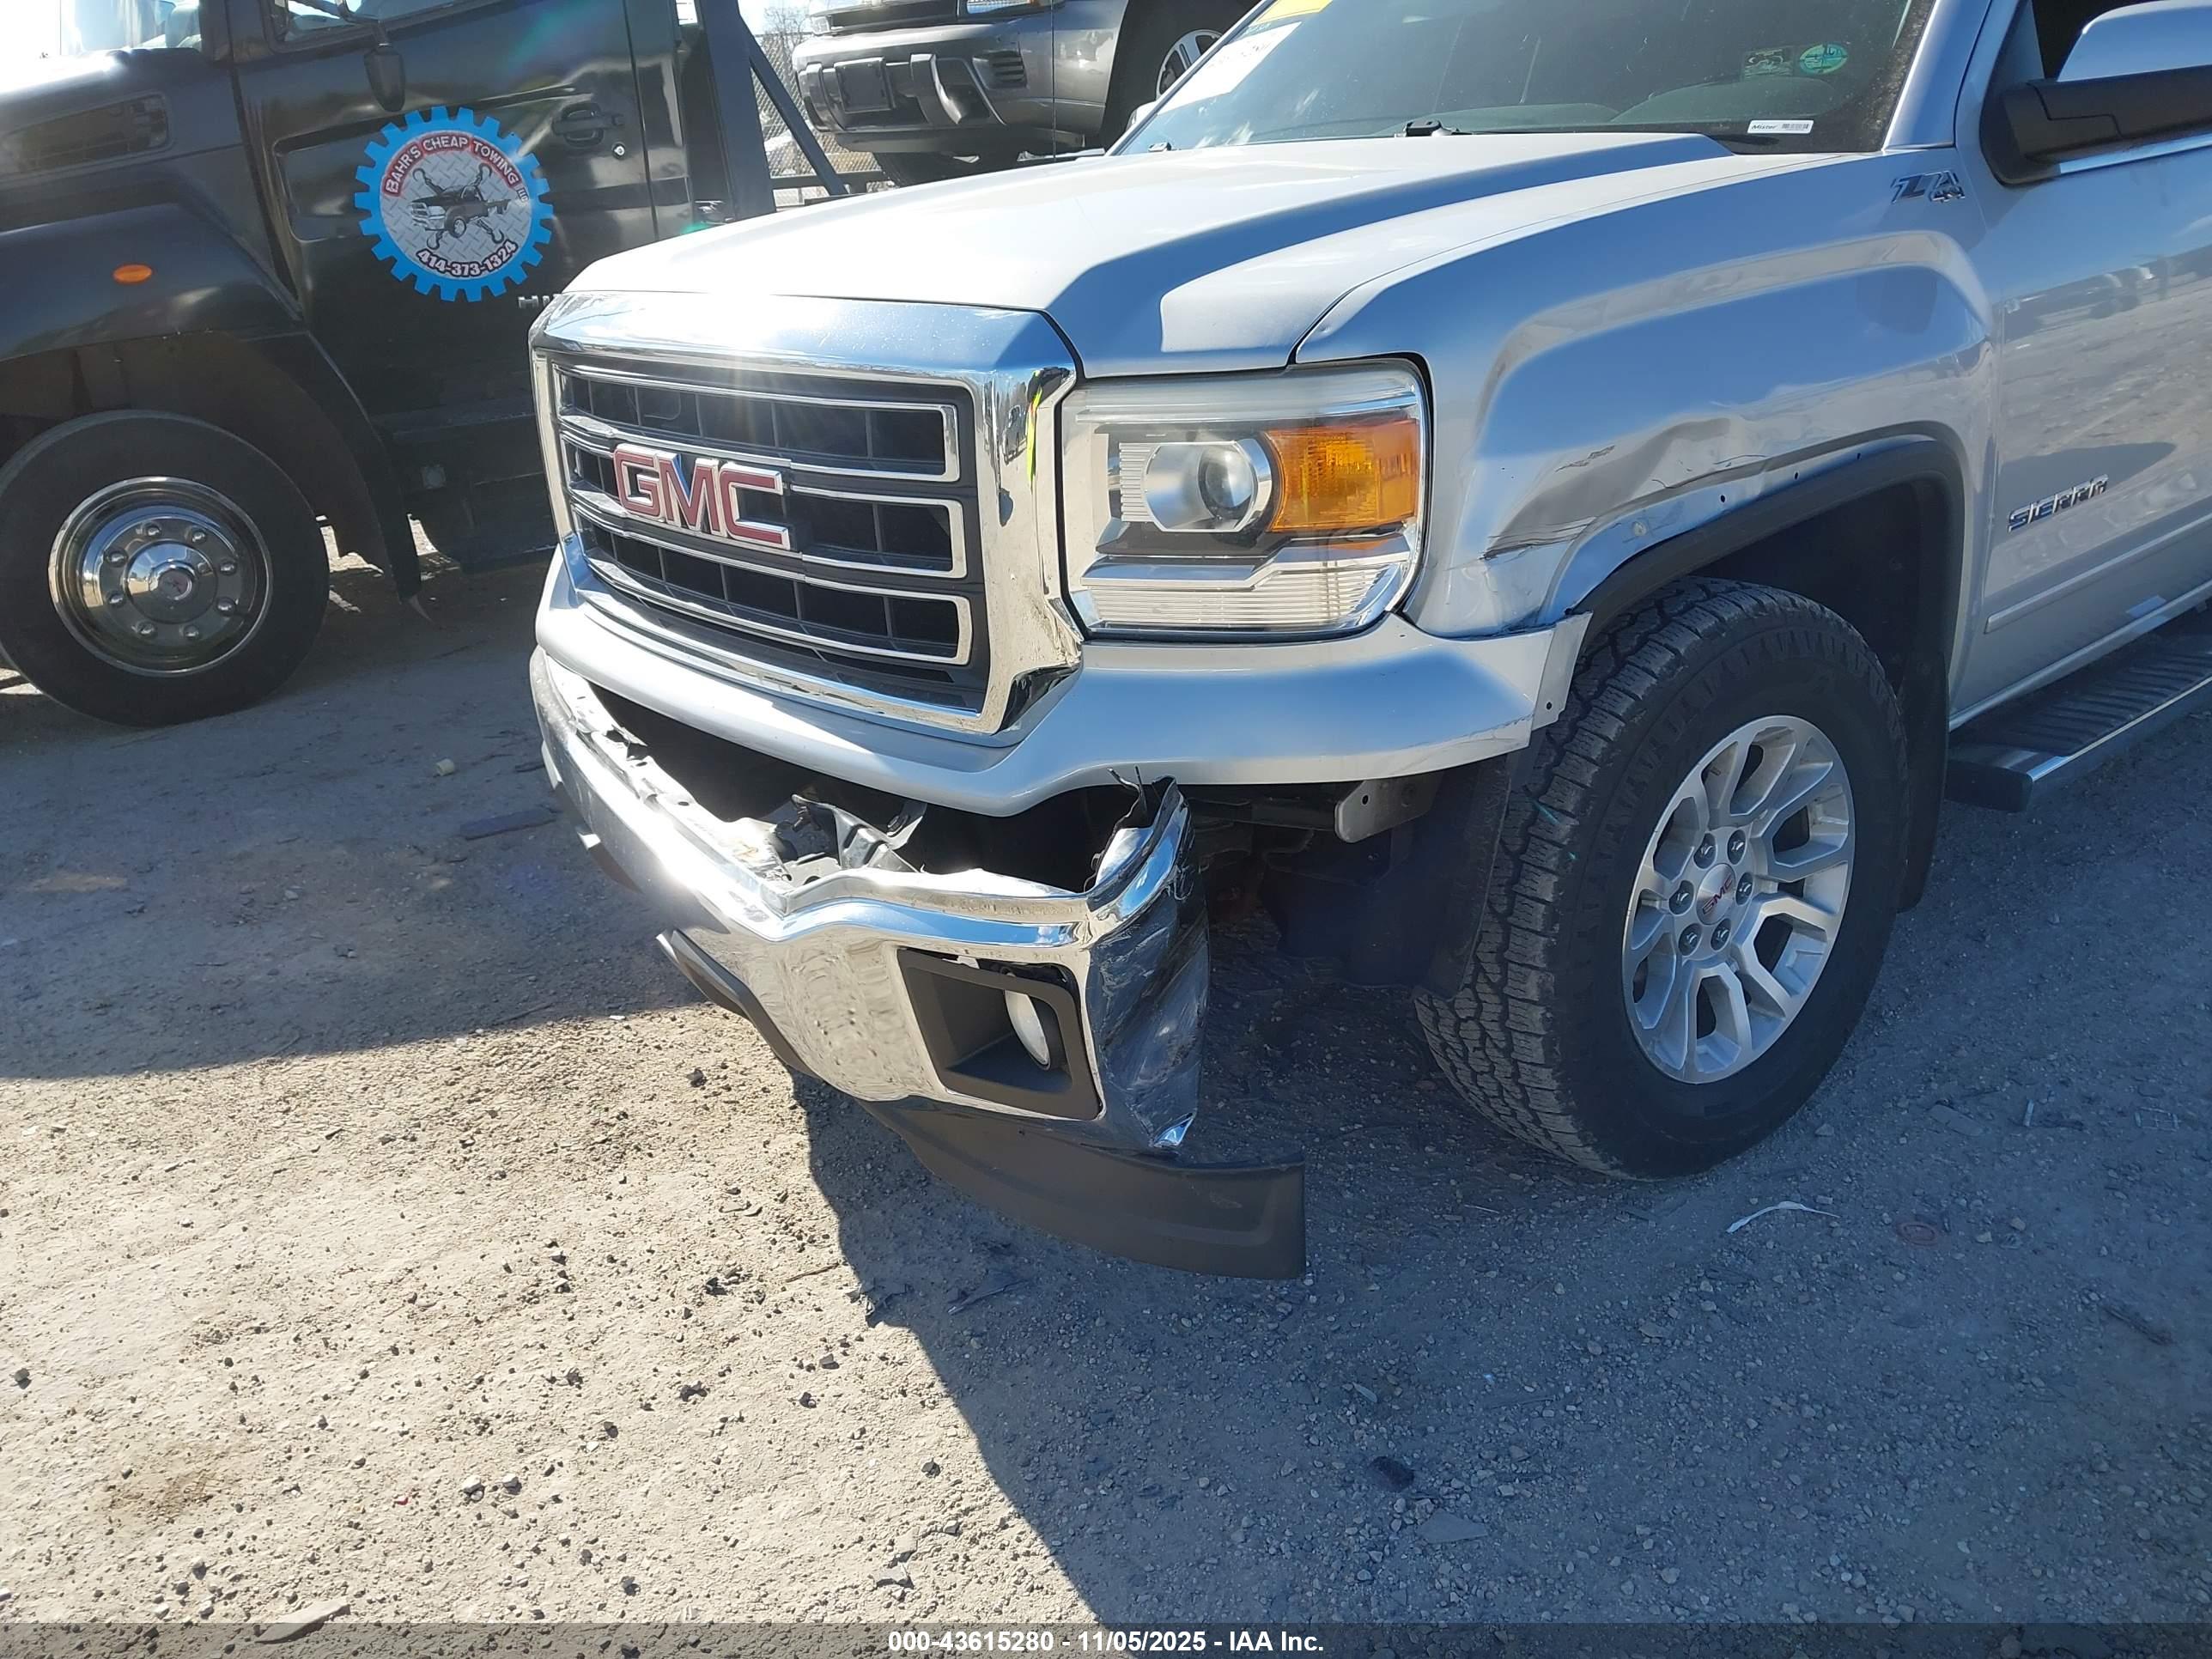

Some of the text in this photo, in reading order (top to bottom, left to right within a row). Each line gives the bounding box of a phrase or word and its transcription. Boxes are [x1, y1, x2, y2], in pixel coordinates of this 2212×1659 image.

[422, 136, 469, 151] CHEAP
[473, 140, 520, 185] TOWING
[416, 240, 518, 277] 414-373-1324
[613, 442, 791, 551] GMC
[2007, 473, 2109, 533] SIERRA
[1701, 872, 1734, 915] GMC
